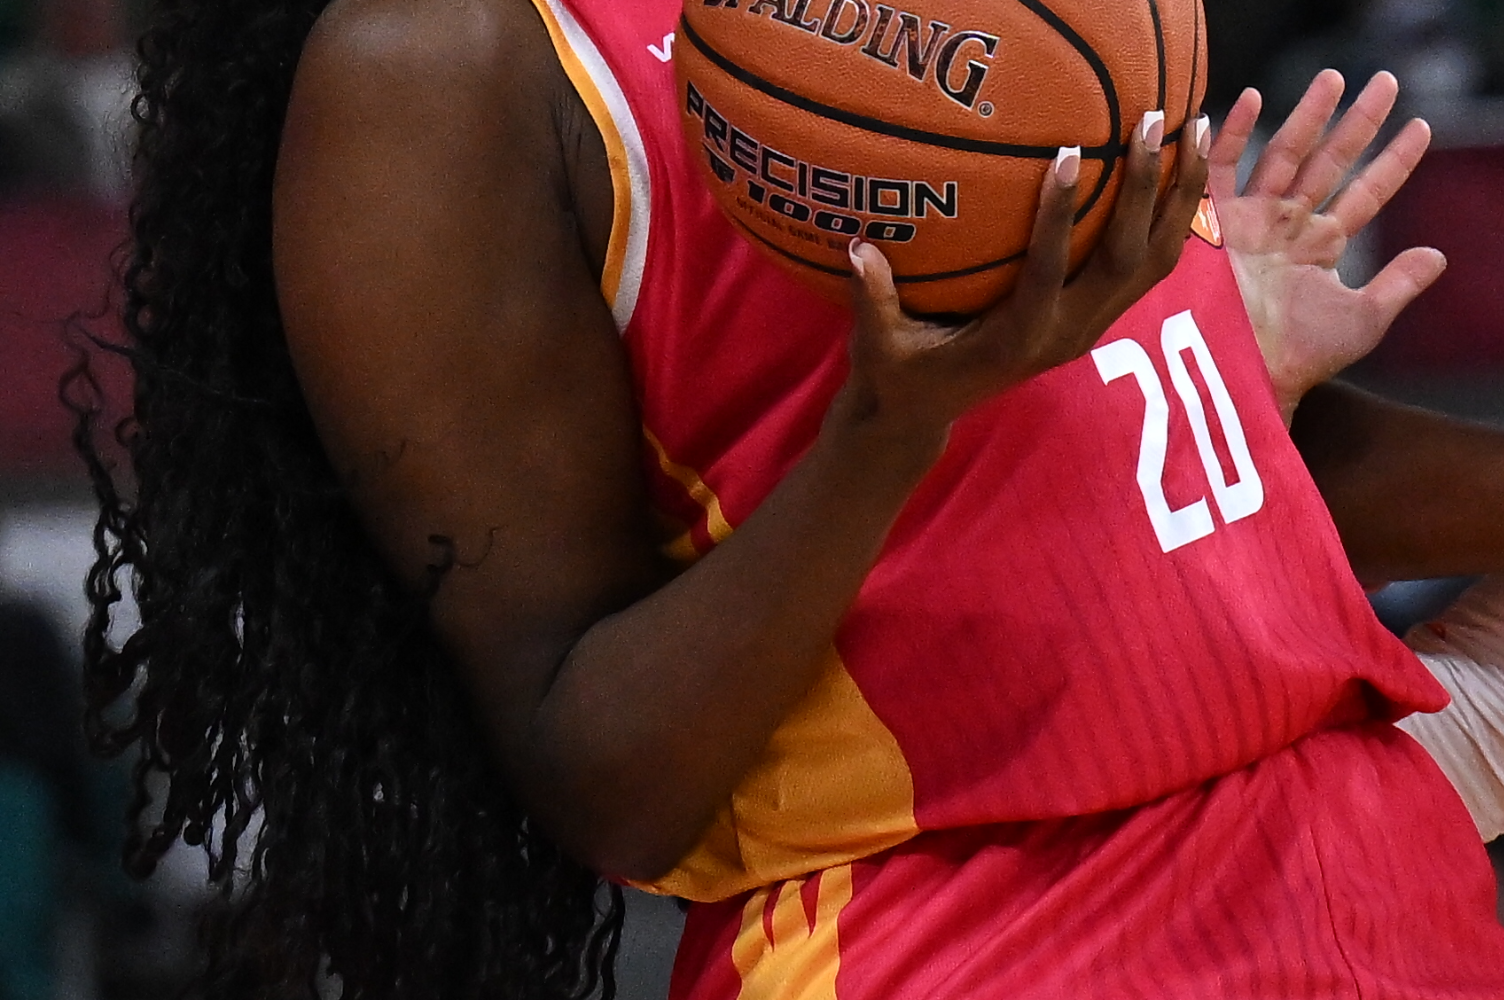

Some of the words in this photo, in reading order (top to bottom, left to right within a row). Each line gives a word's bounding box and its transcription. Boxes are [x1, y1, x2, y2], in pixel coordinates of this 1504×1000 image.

[685, 79, 958, 219] PRECISION
[747, 179, 917, 243] 1000
[1090, 309, 1264, 554] 20
